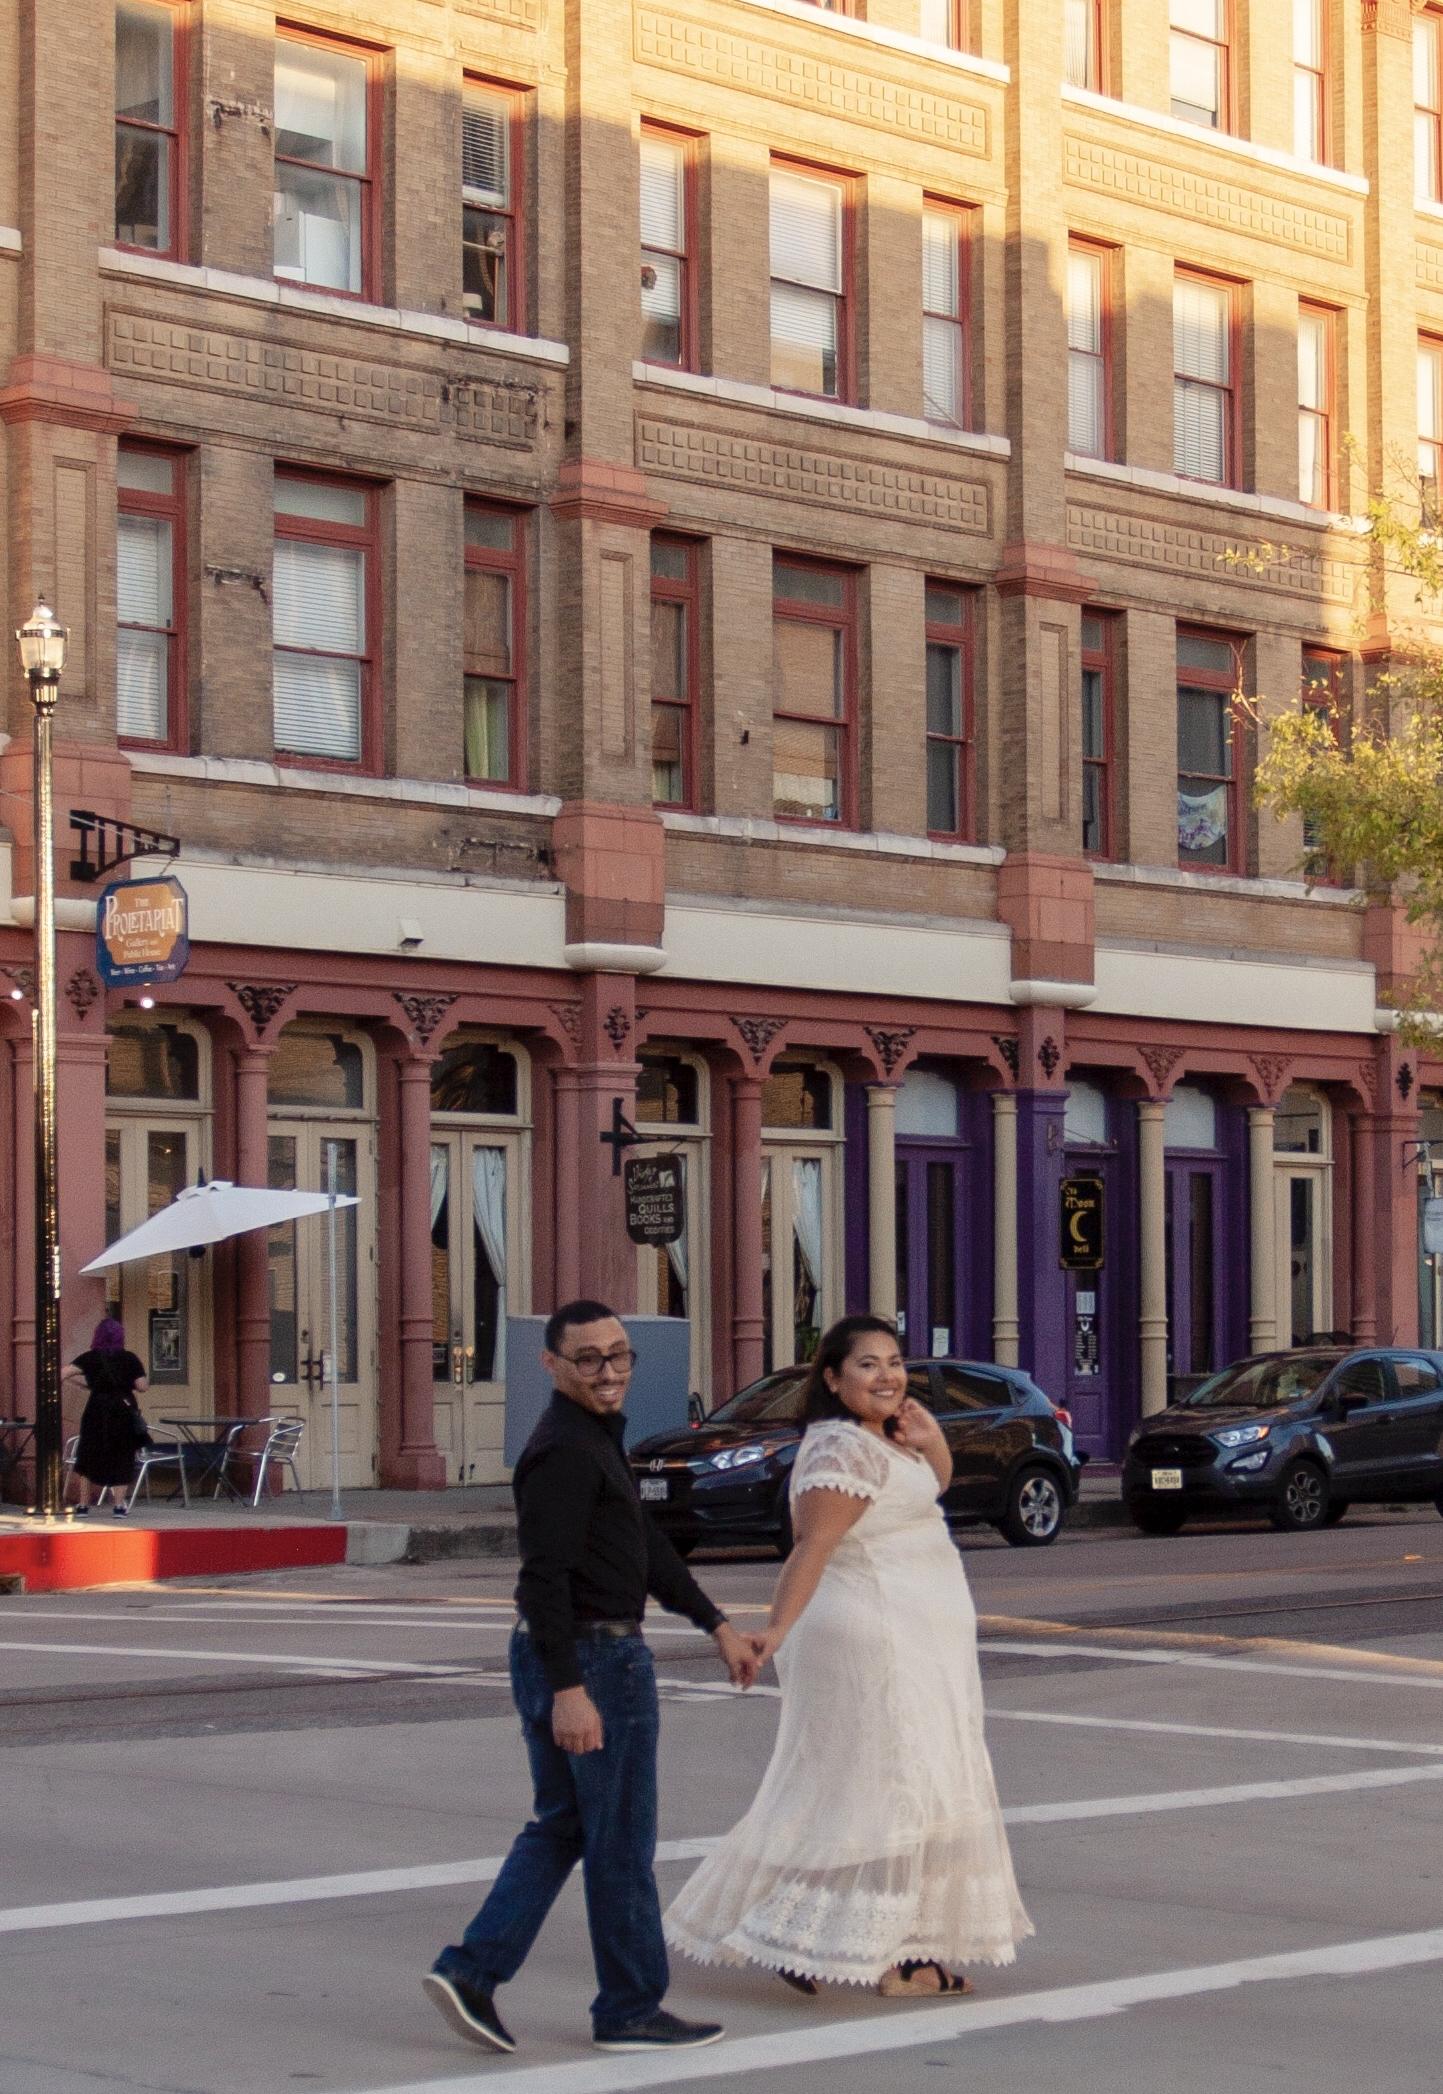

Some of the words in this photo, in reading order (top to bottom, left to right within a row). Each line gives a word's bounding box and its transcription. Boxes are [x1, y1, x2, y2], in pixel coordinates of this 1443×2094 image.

[105, 895, 184, 942] PROLETARIAT
[638, 1203, 674, 1214] QUILLS
[630, 1213, 661, 1225] BOOKS
